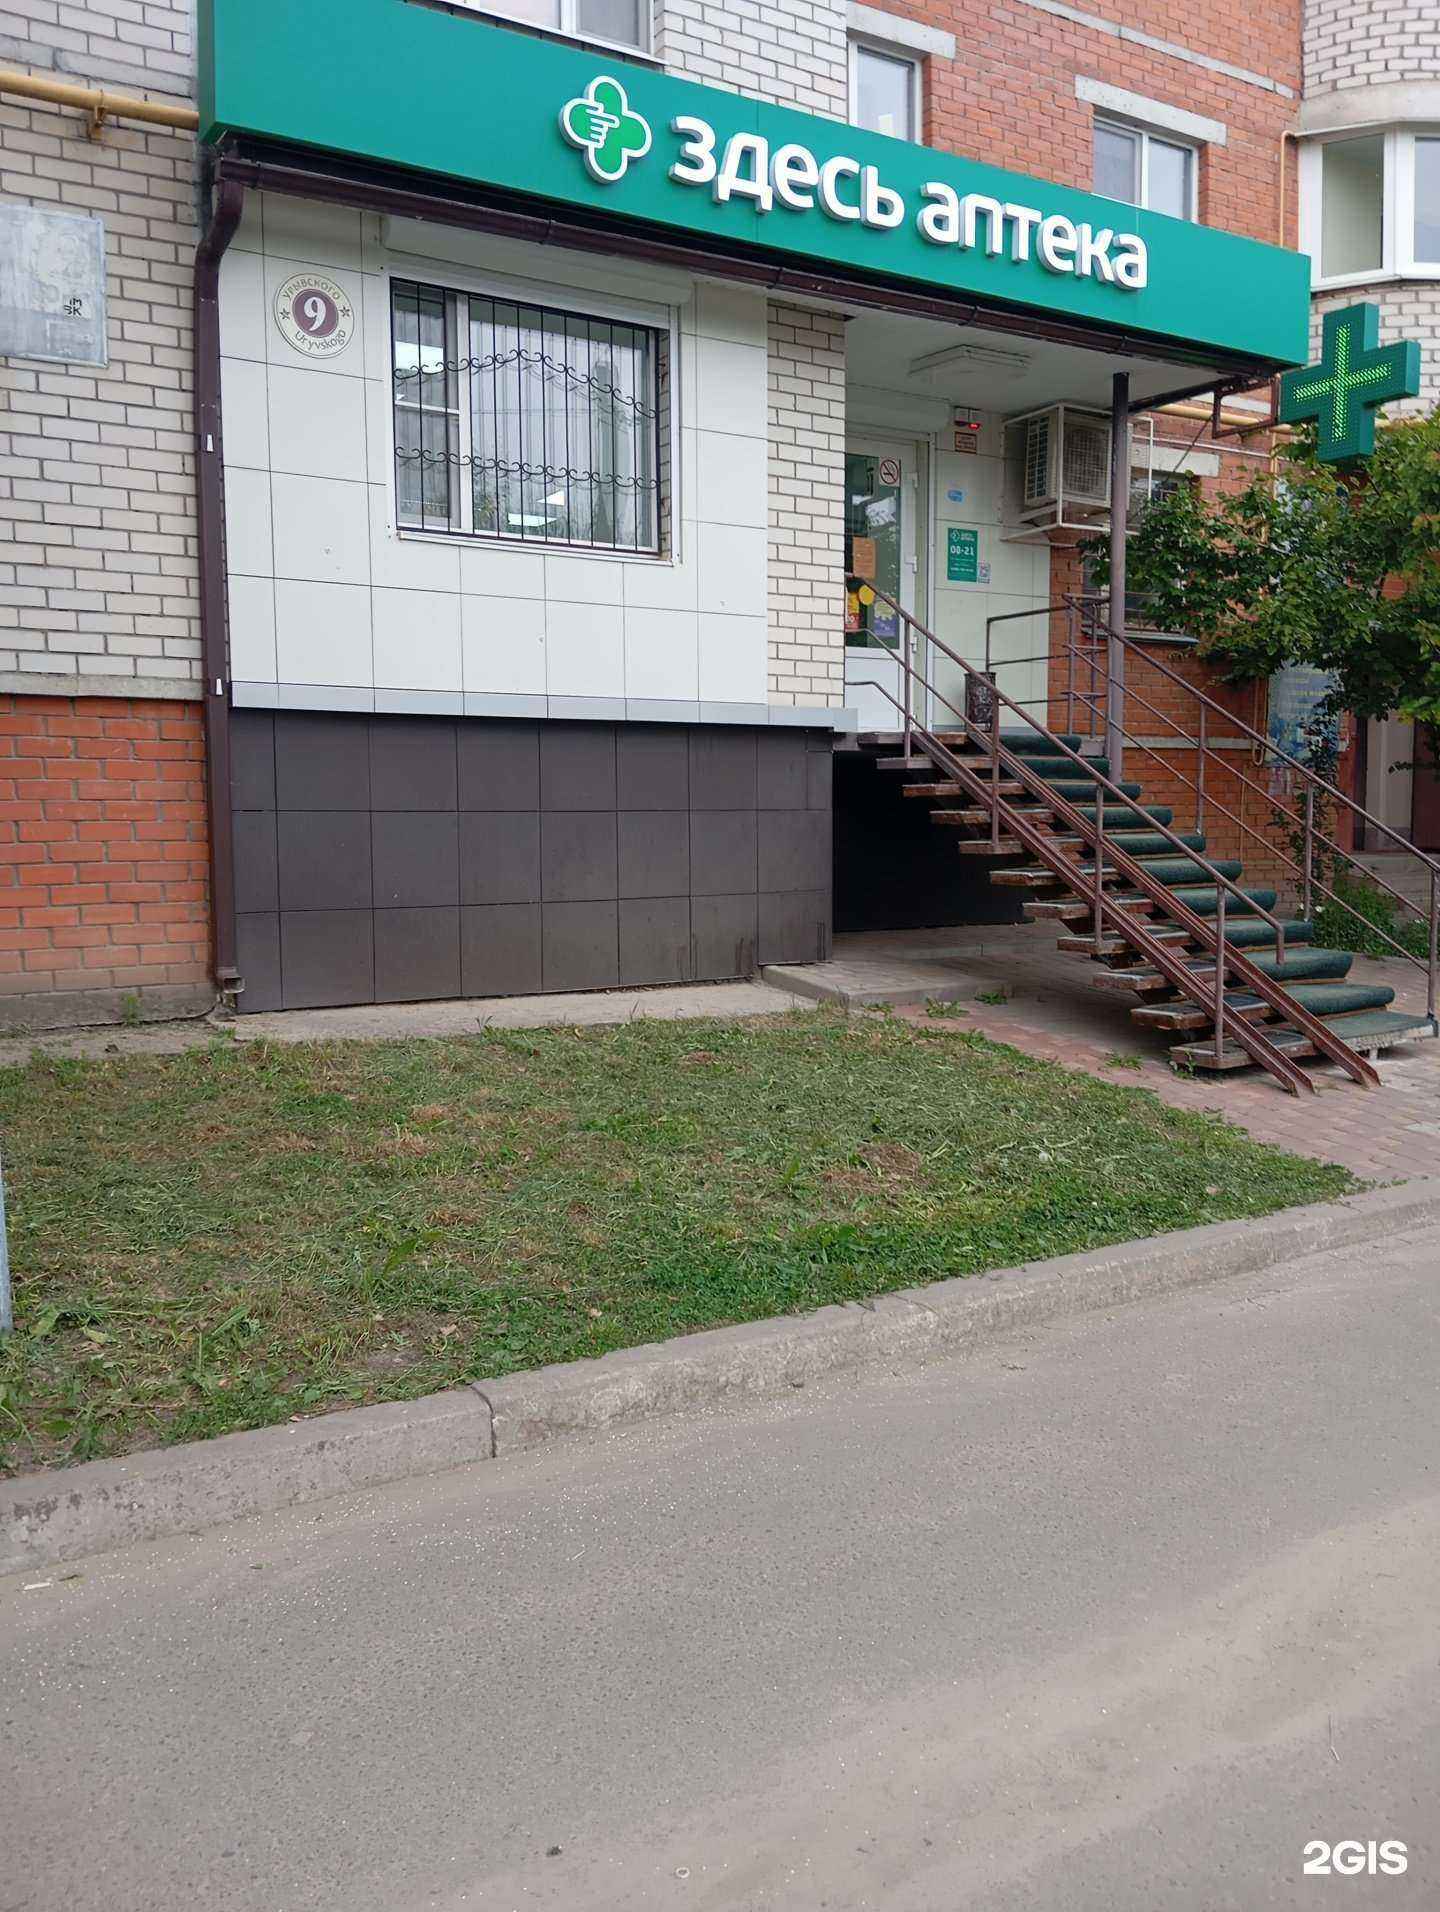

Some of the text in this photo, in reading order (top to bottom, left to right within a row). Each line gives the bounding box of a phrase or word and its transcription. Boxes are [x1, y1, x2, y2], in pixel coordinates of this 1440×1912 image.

[916, 182, 1149, 290] аптека
[303, 296, 327, 332] 9
[295, 329, 346, 350] Uryvskogo
